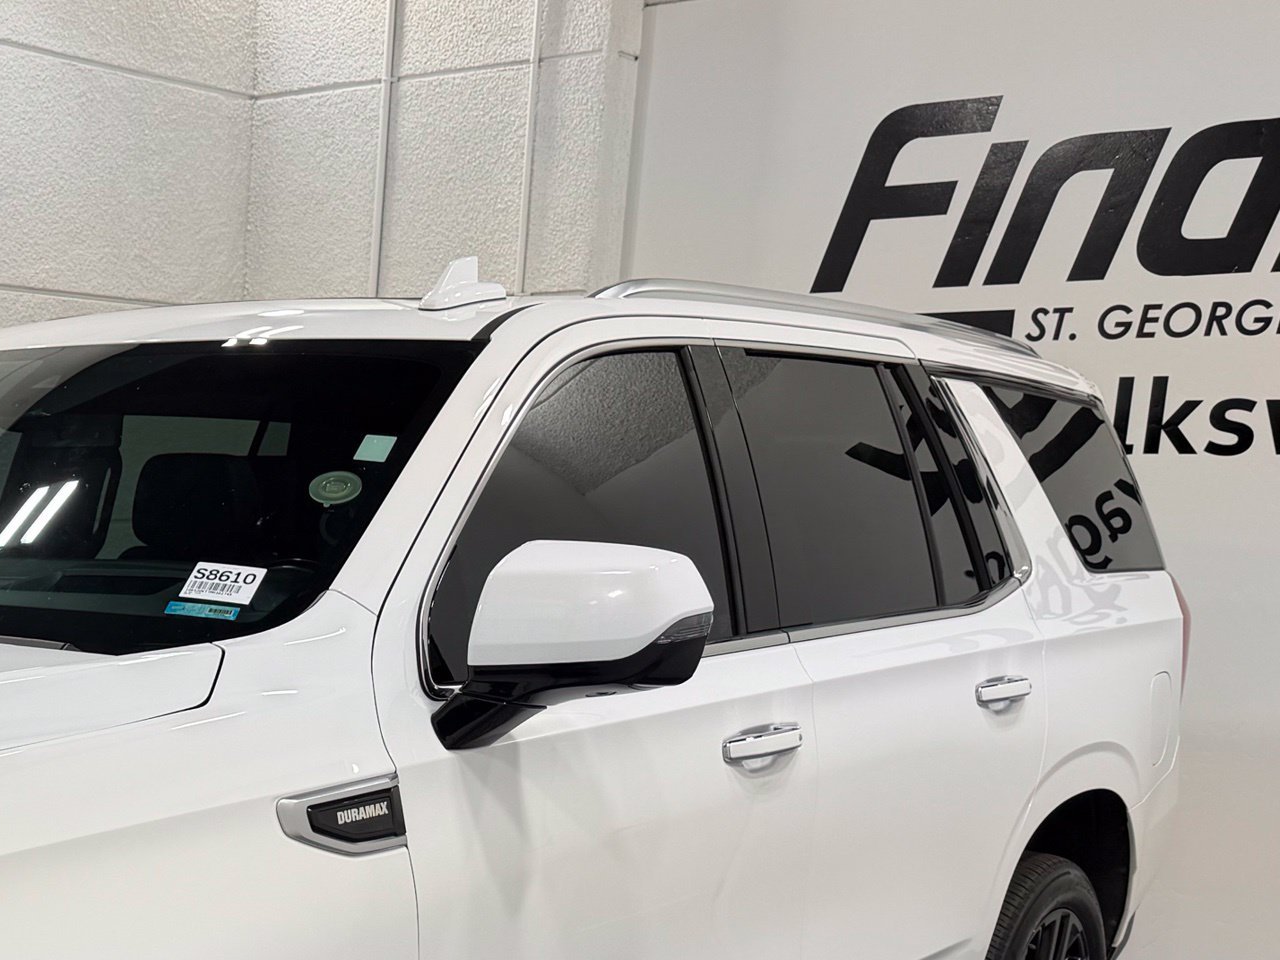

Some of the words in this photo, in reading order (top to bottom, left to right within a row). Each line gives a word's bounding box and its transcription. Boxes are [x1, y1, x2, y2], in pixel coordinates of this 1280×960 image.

[1024, 306, 1078, 342] ST.
[1097, 298, 1280, 340] GEORG
[193, 567, 257, 585] S8610
[336, 801, 389, 825] DURAMAX
